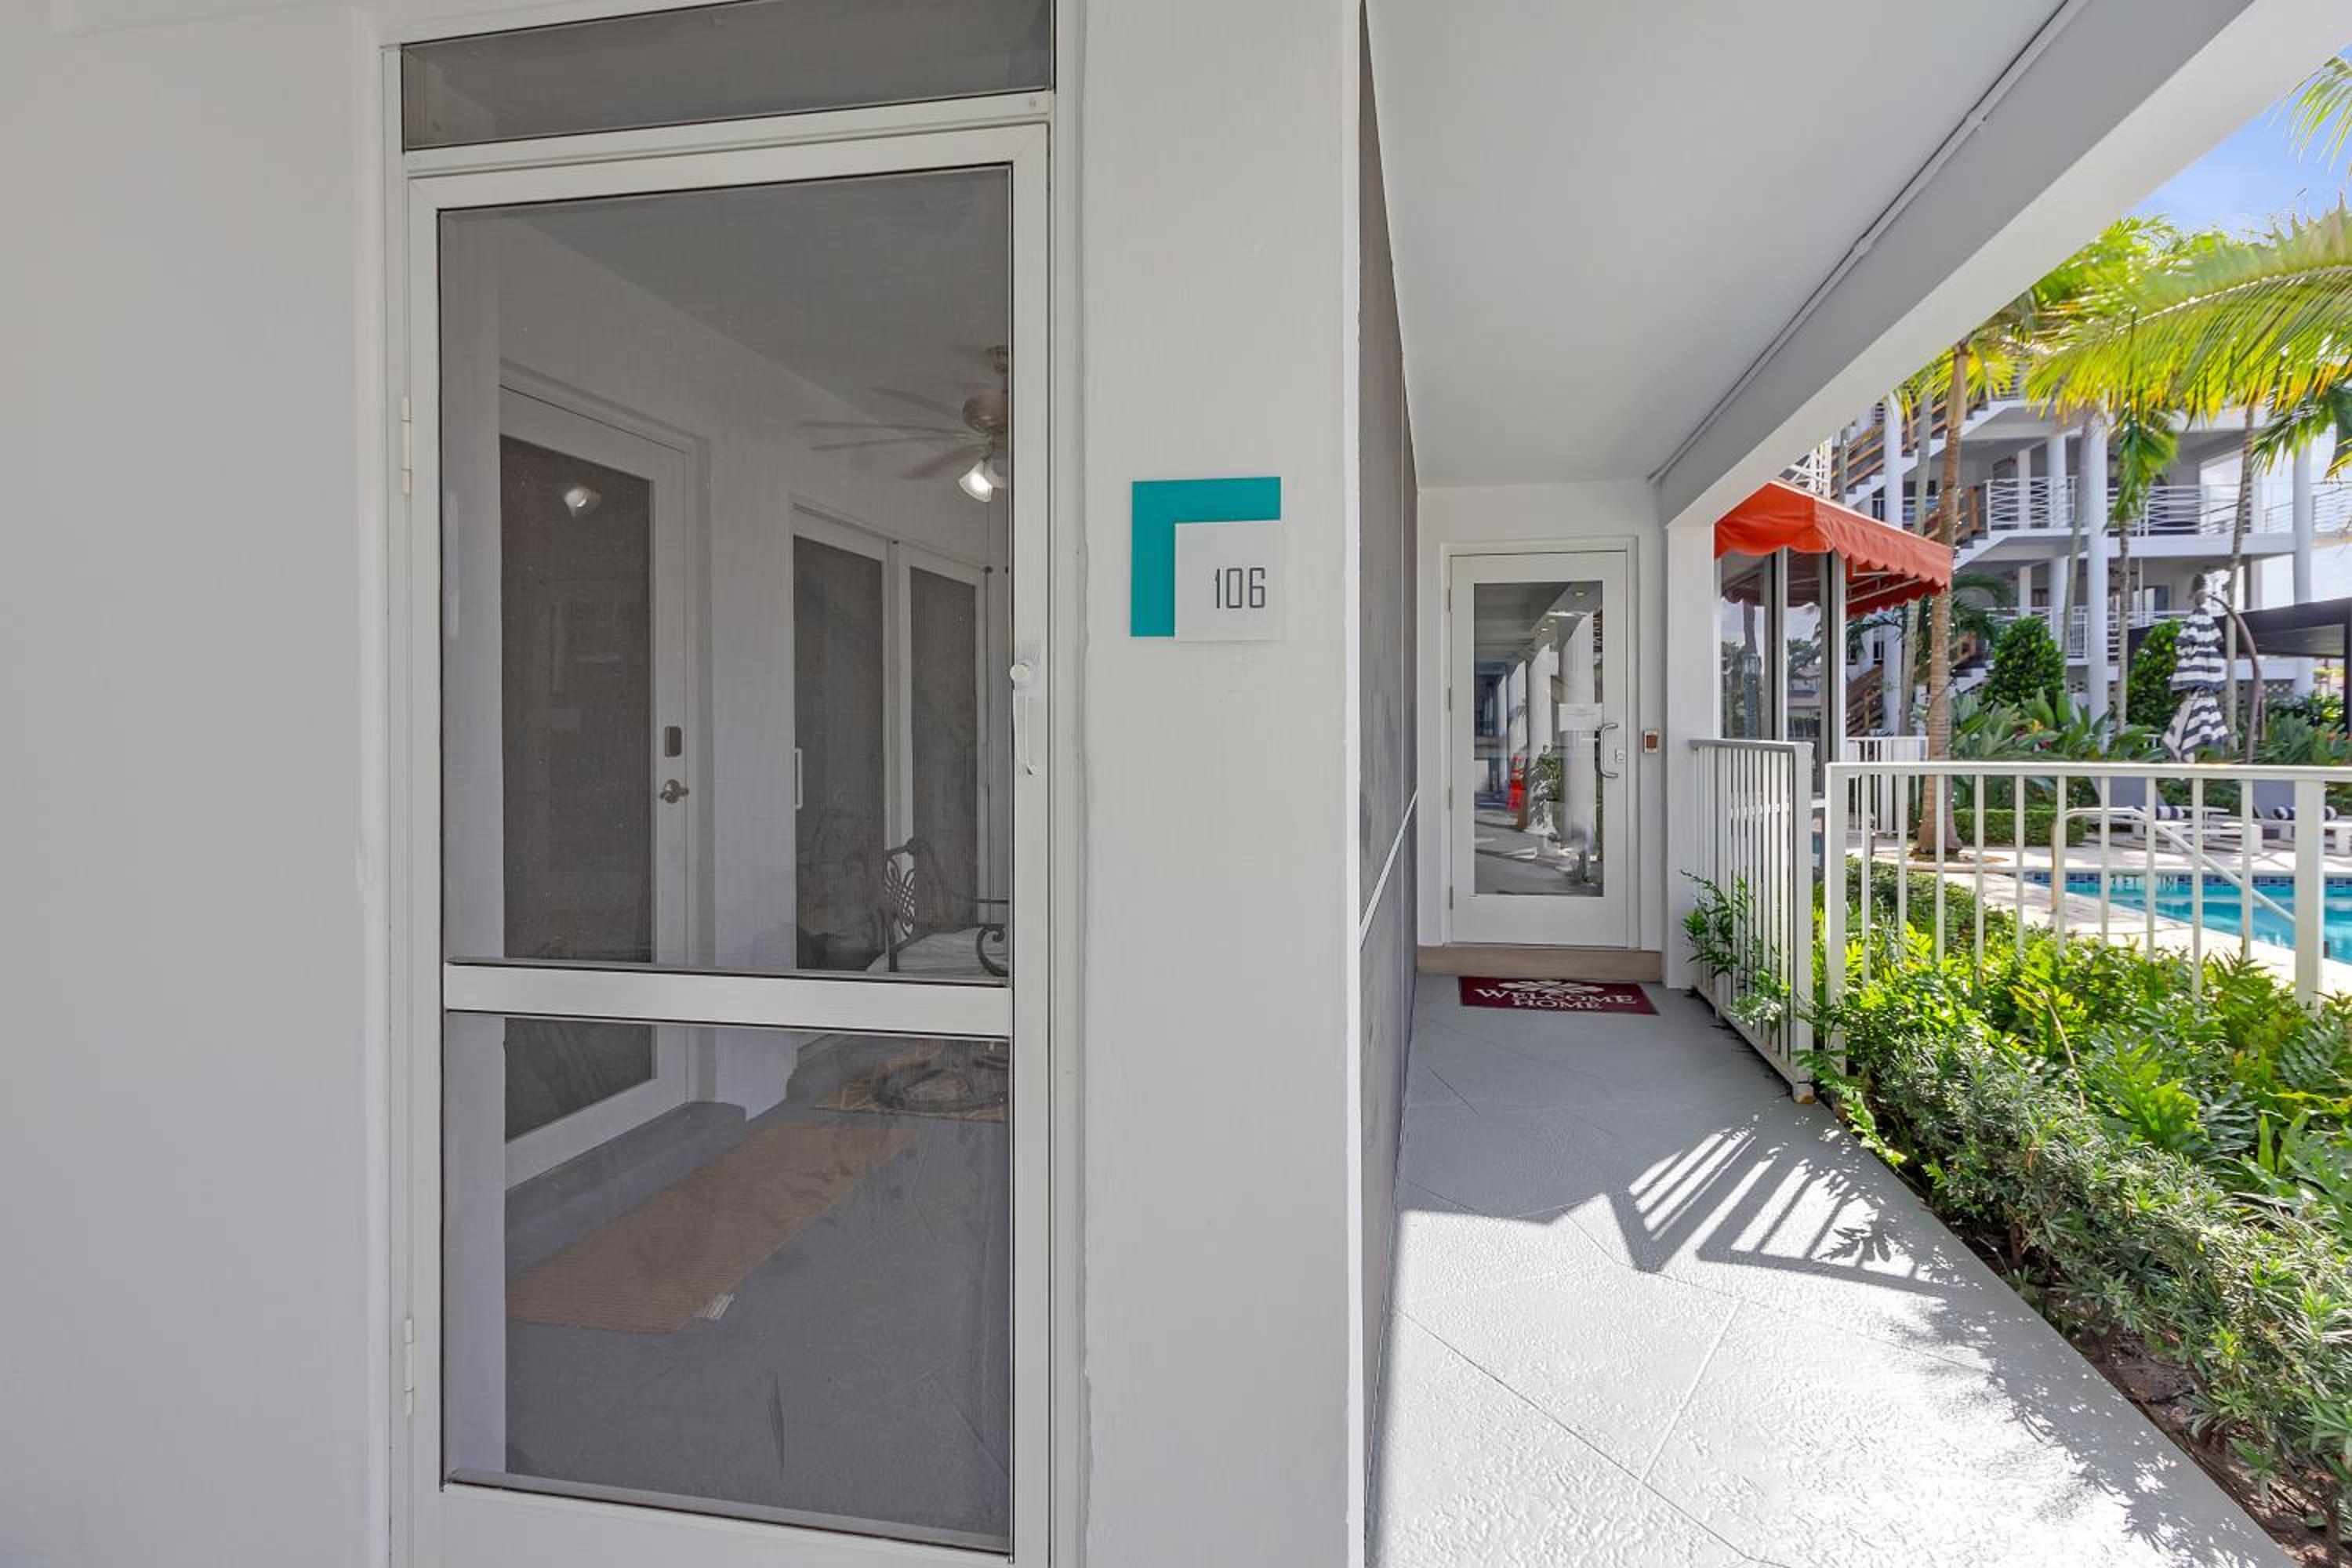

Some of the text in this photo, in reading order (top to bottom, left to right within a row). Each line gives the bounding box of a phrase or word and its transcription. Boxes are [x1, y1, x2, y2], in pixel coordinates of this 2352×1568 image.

[1214, 567, 1265, 609] 106
[1474, 989, 1637, 1004] WELCOME
[1511, 998, 1604, 1010] HOME
